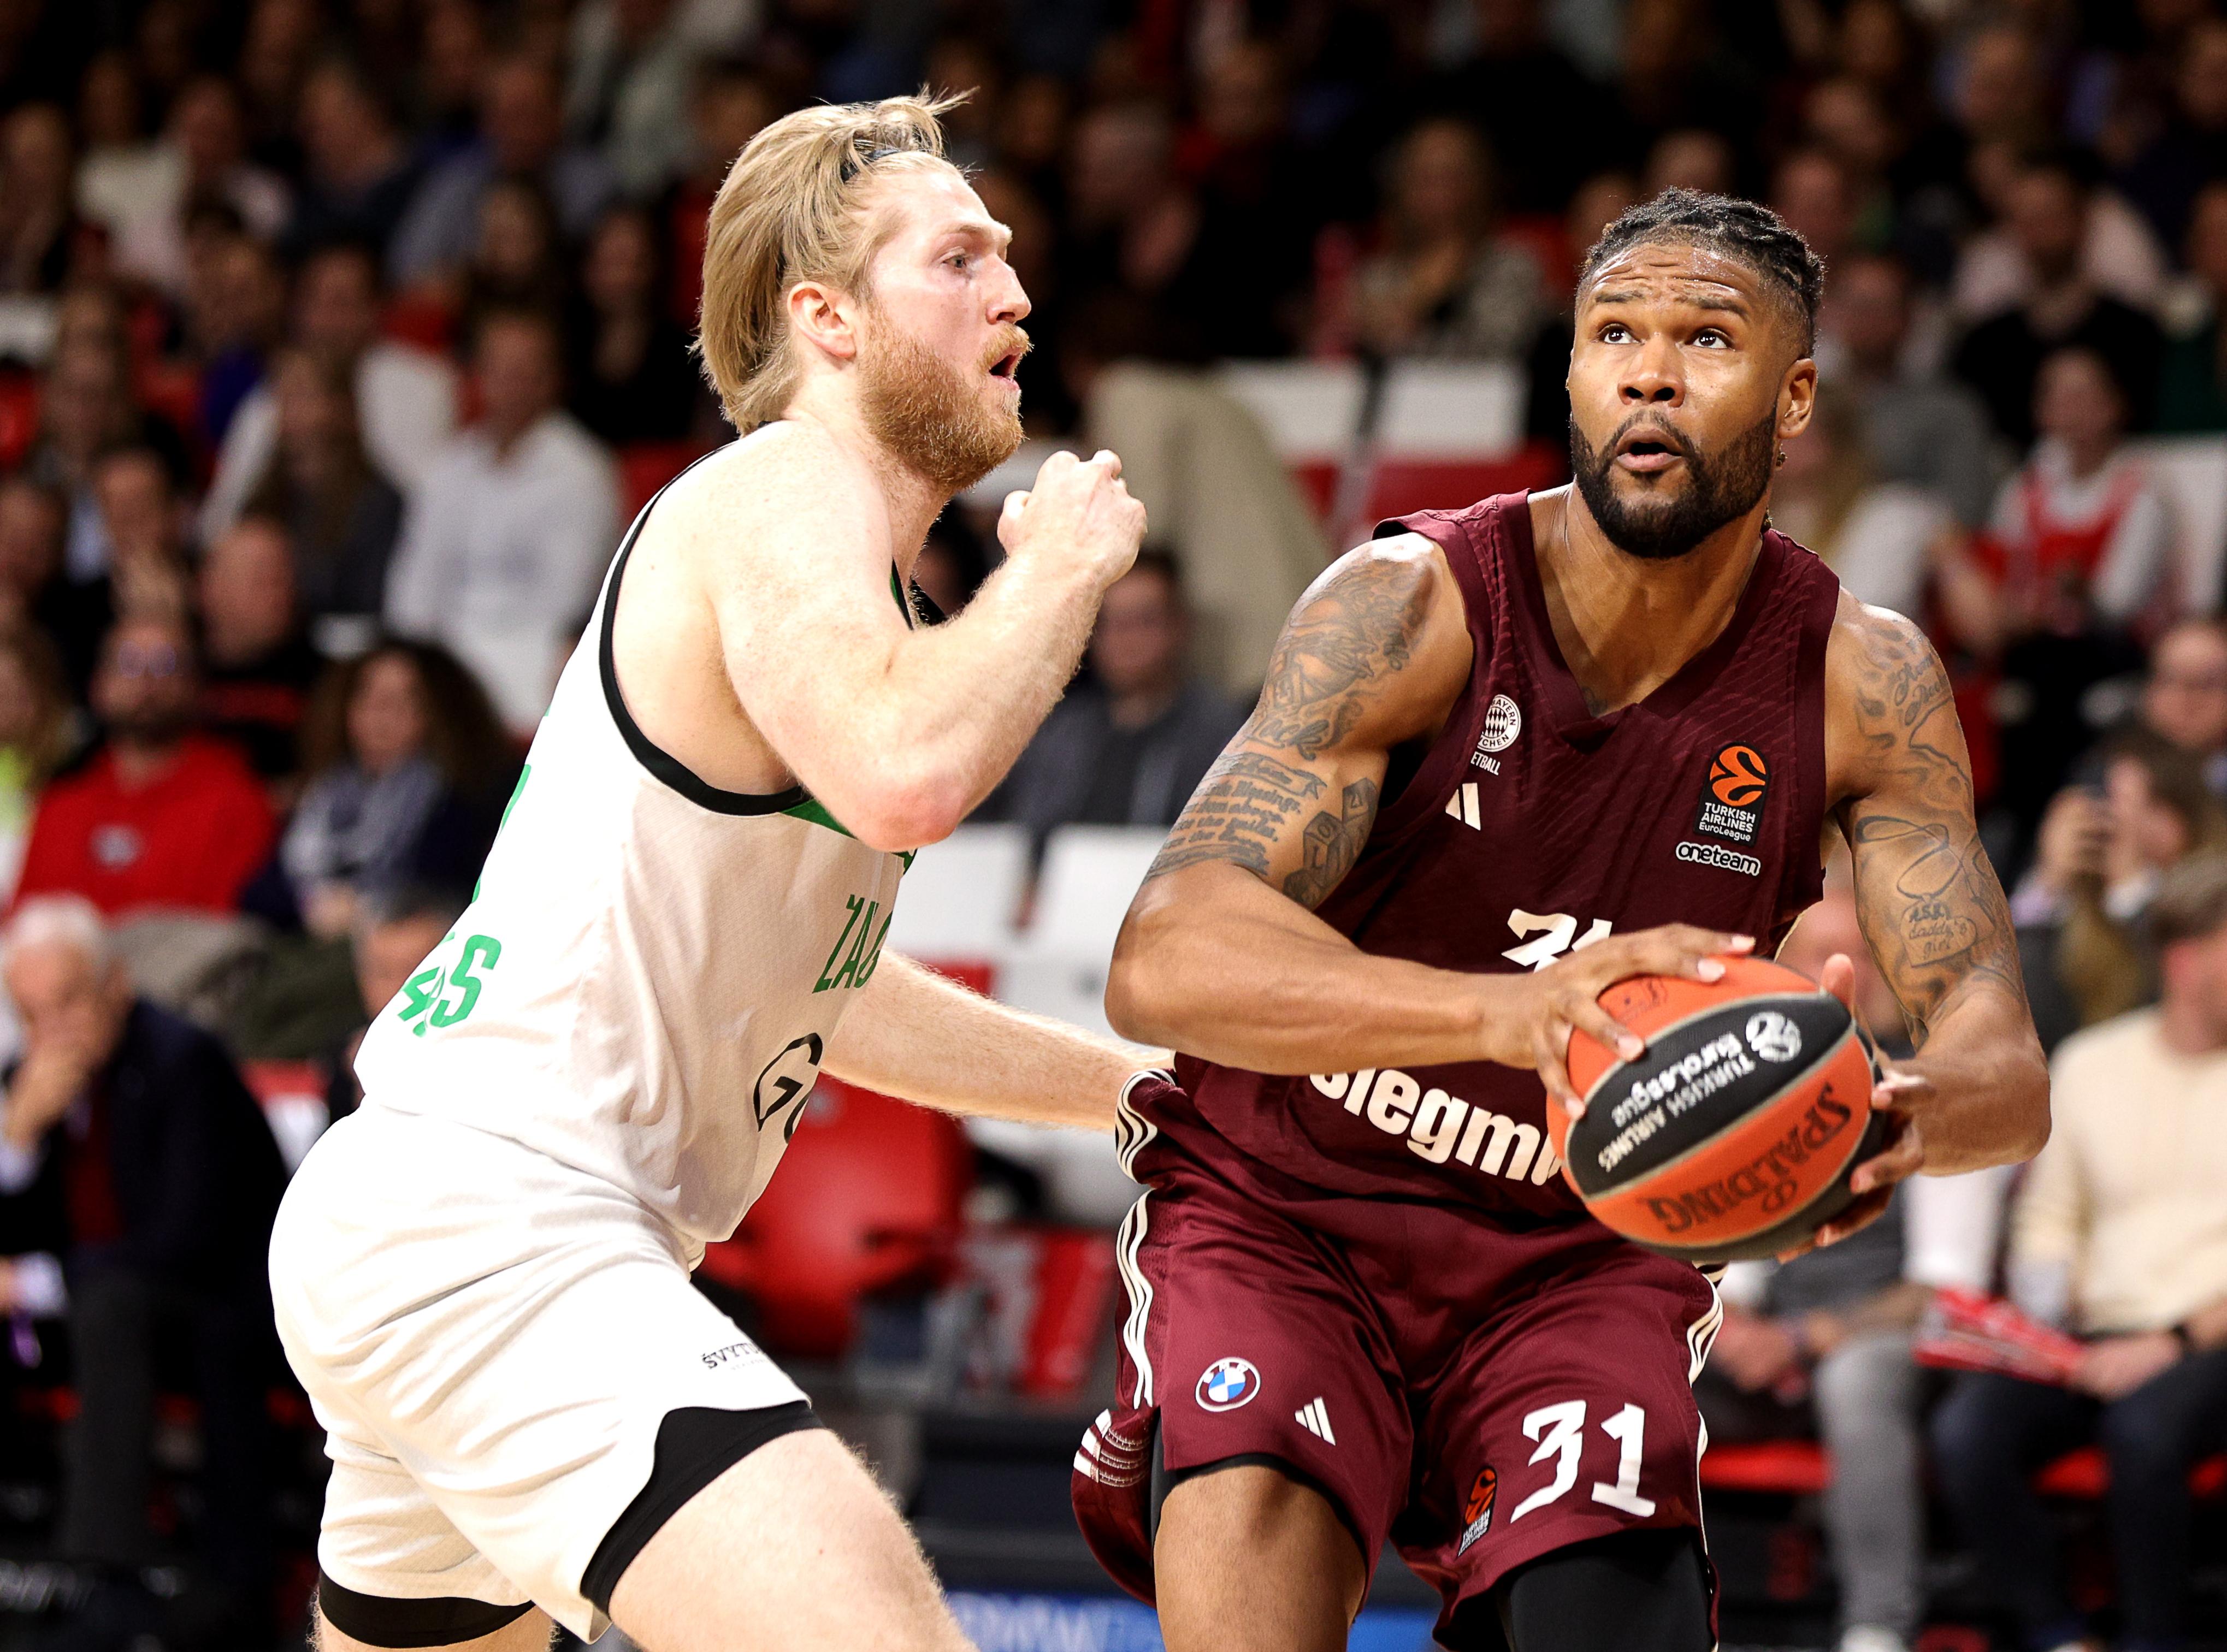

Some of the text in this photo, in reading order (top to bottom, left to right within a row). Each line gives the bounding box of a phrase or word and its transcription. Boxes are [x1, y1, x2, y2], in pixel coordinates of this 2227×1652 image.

[1700, 812, 1754, 833] AIRLINES
[1704, 802, 1756, 824] TURKISH
[1698, 821, 1751, 842] EuroLeague
[1677, 843, 1760, 875] oneteam
[1646, 1081, 1852, 1233] SPALDING
[1510, 1399, 1656, 1524] 31
